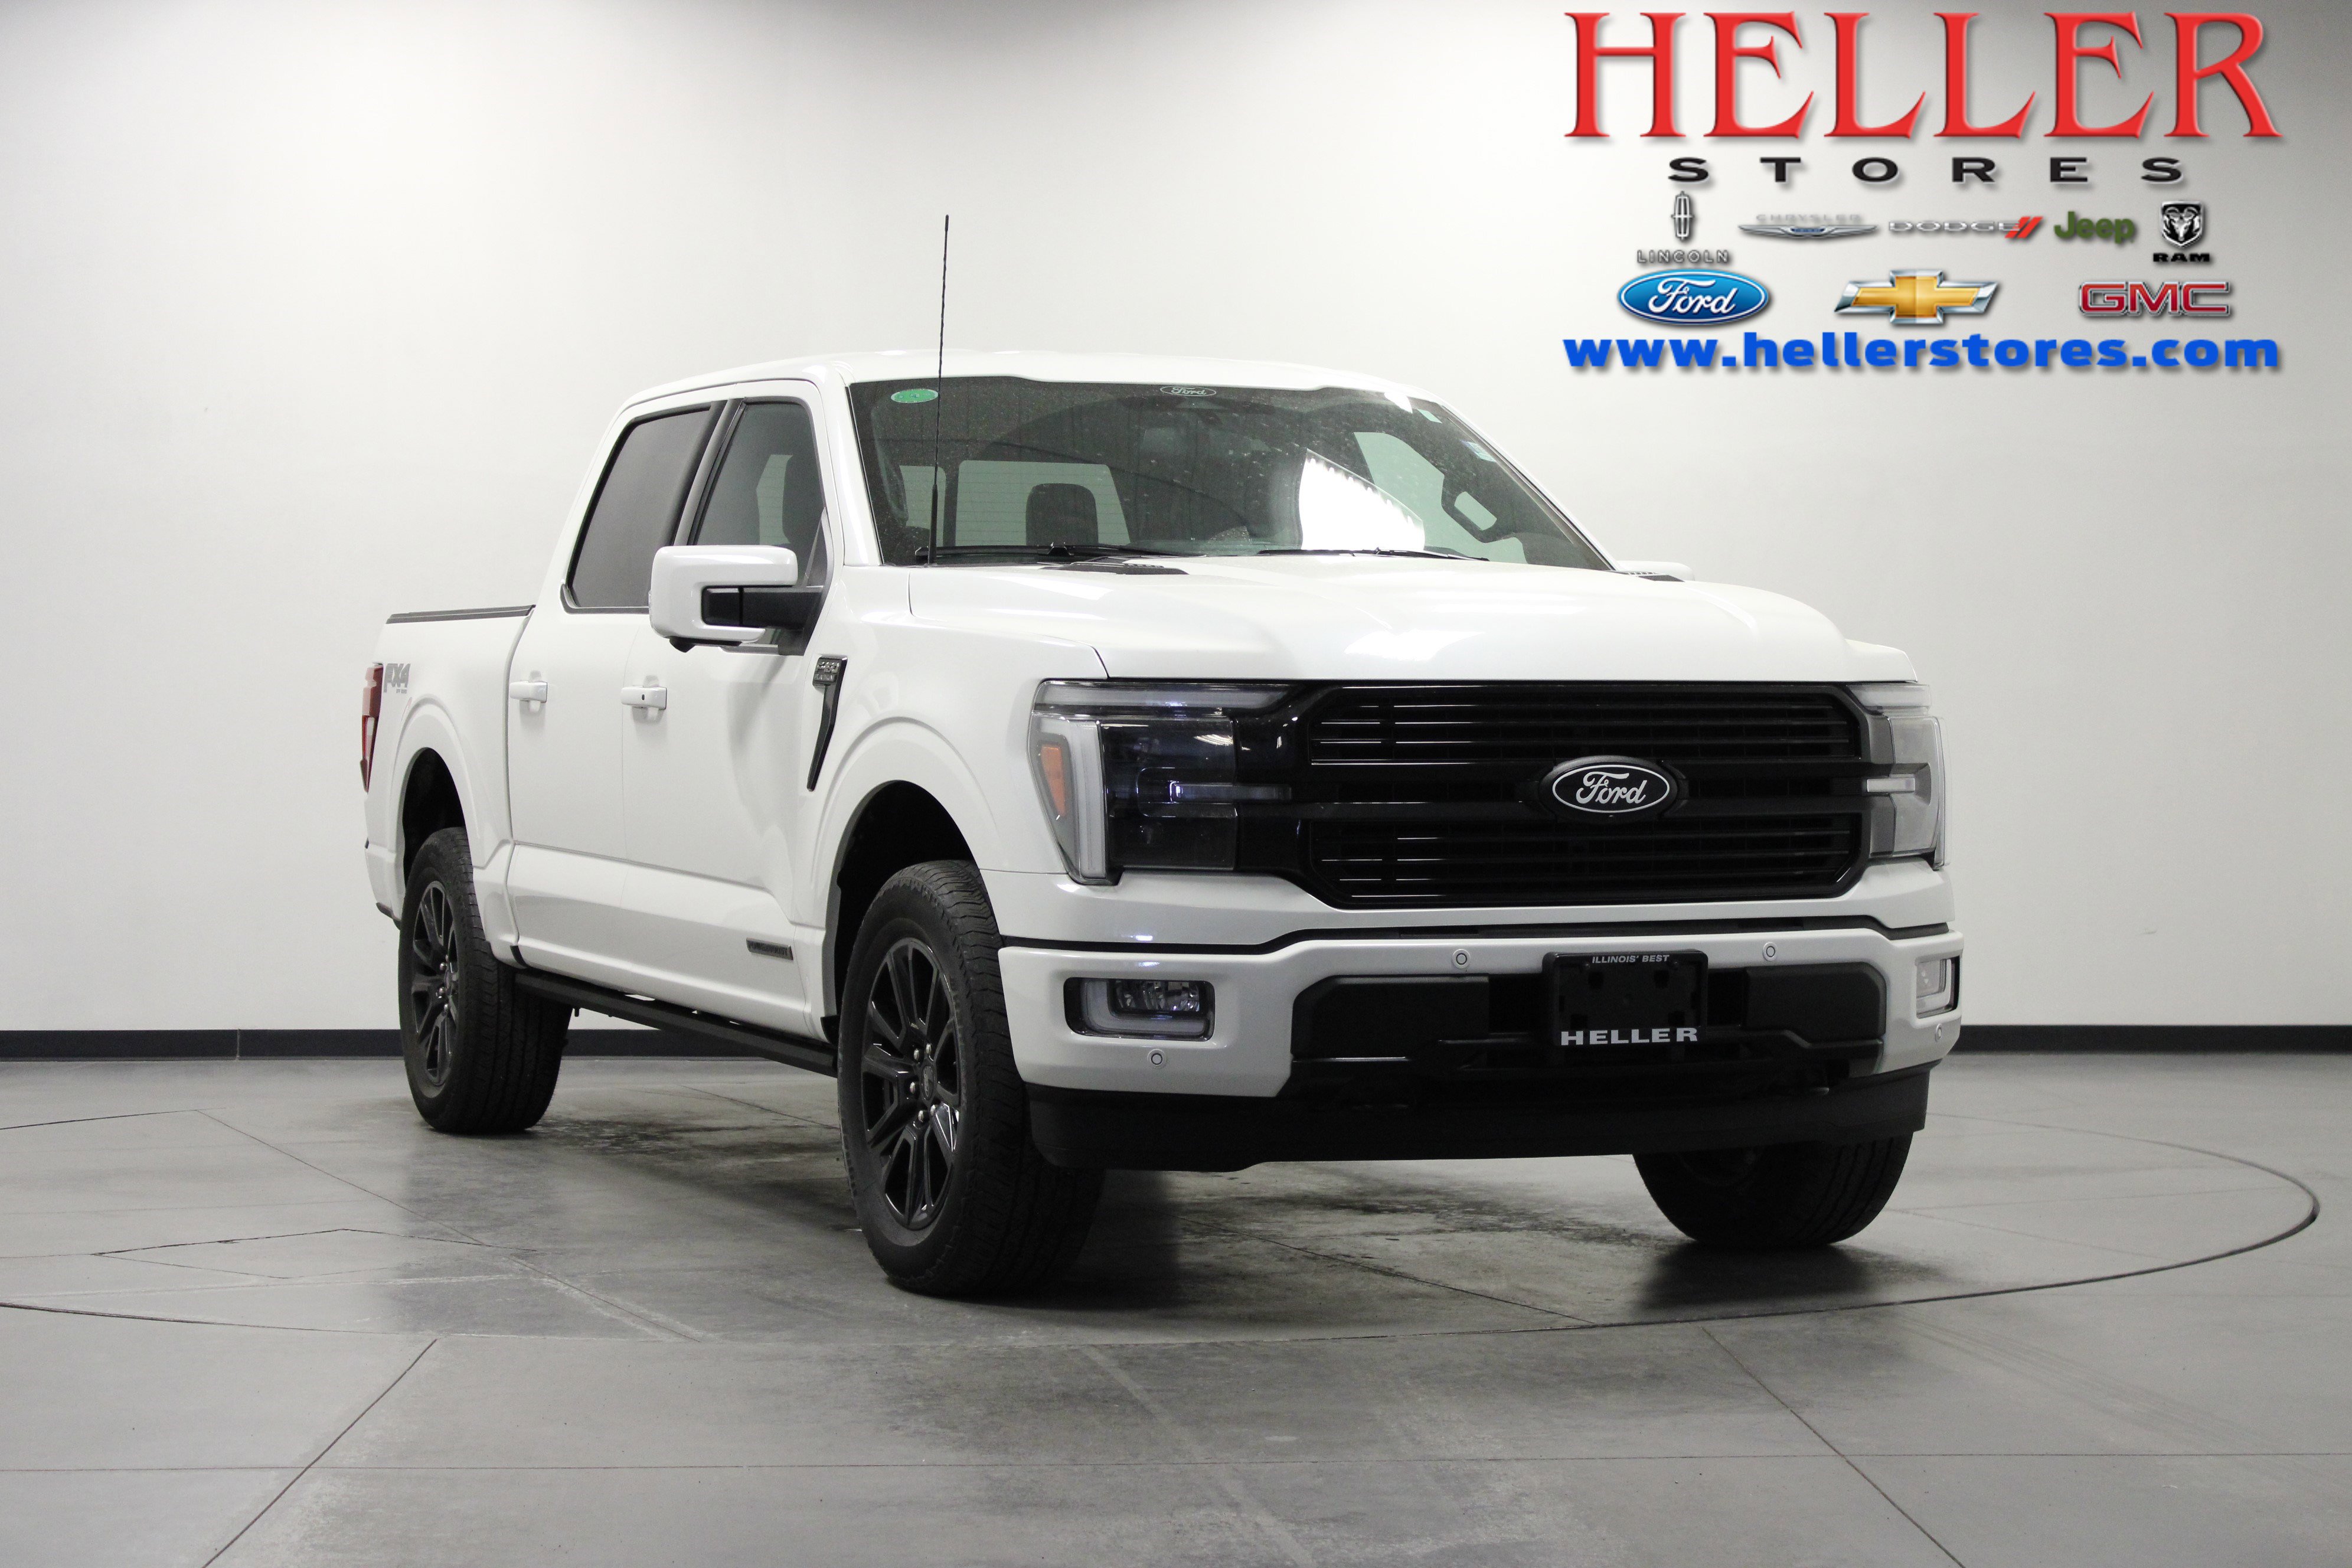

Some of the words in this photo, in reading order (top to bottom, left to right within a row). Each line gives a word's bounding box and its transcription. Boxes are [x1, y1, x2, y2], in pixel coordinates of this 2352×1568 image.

[1171, 387, 1207, 395] Ford
[383, 663, 411, 692] FX4
[1576, 771, 1648, 804] Ford
[1592, 955, 1639, 963] ILLINOIS'
[1560, 1027, 1698, 1046] HELLER
